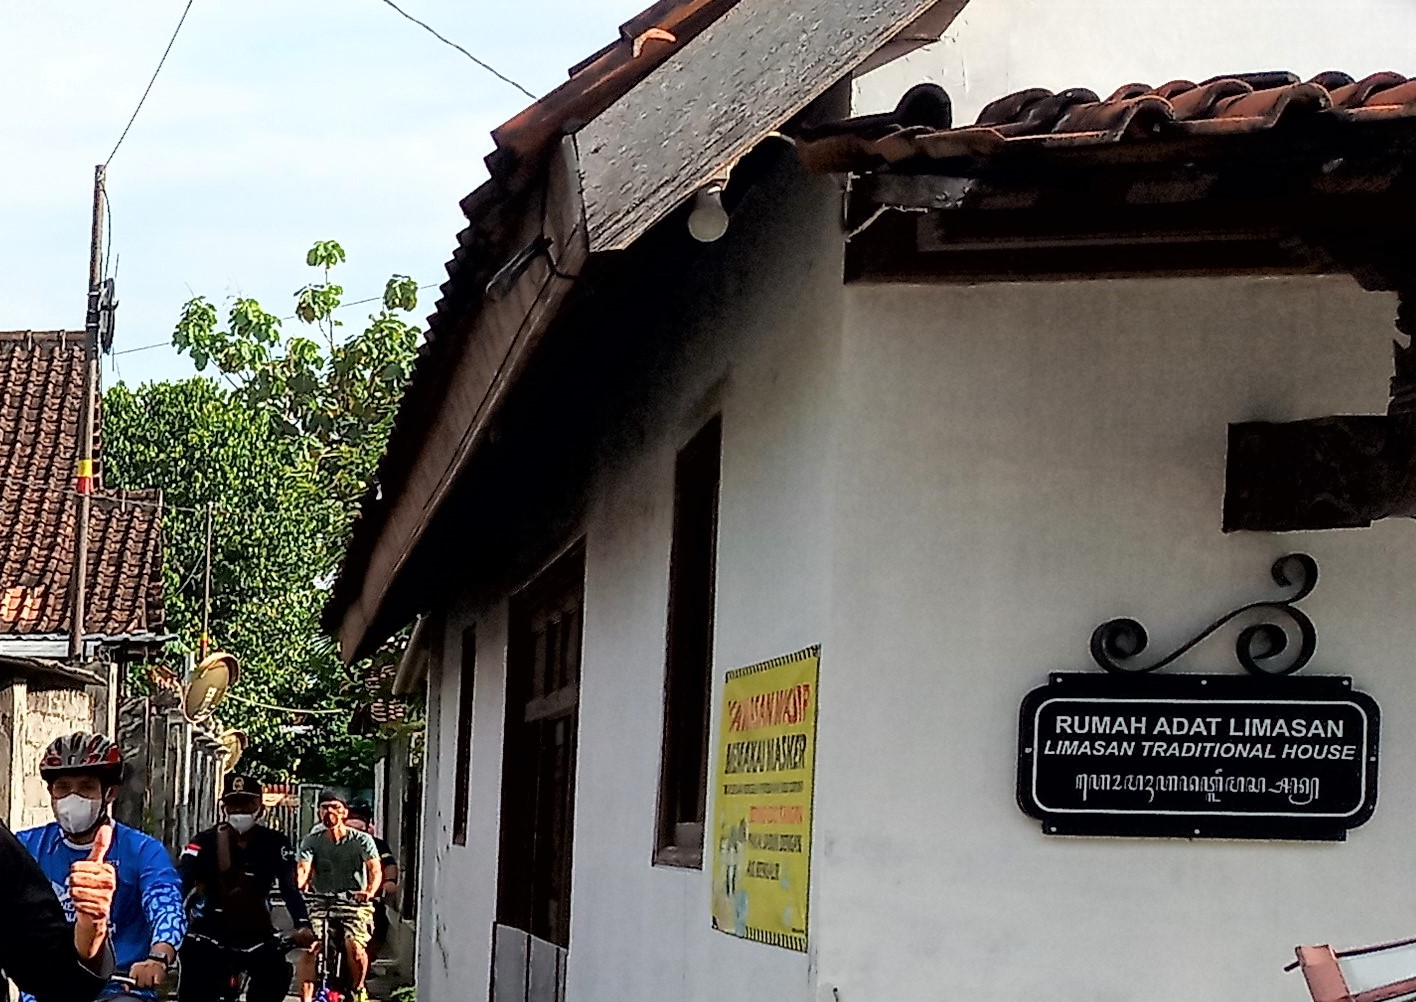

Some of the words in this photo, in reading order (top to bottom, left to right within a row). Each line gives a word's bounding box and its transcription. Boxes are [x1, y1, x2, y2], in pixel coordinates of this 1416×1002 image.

[1056, 715, 1147, 735] RUMAH
[1152, 717, 1222, 735] ADAT
[1229, 718, 1344, 738] LIMASAN
[1044, 740, 1135, 756] LIMASAN
[1141, 741, 1276, 759] TRADITIONAL
[1282, 744, 1357, 760] HOUSE
